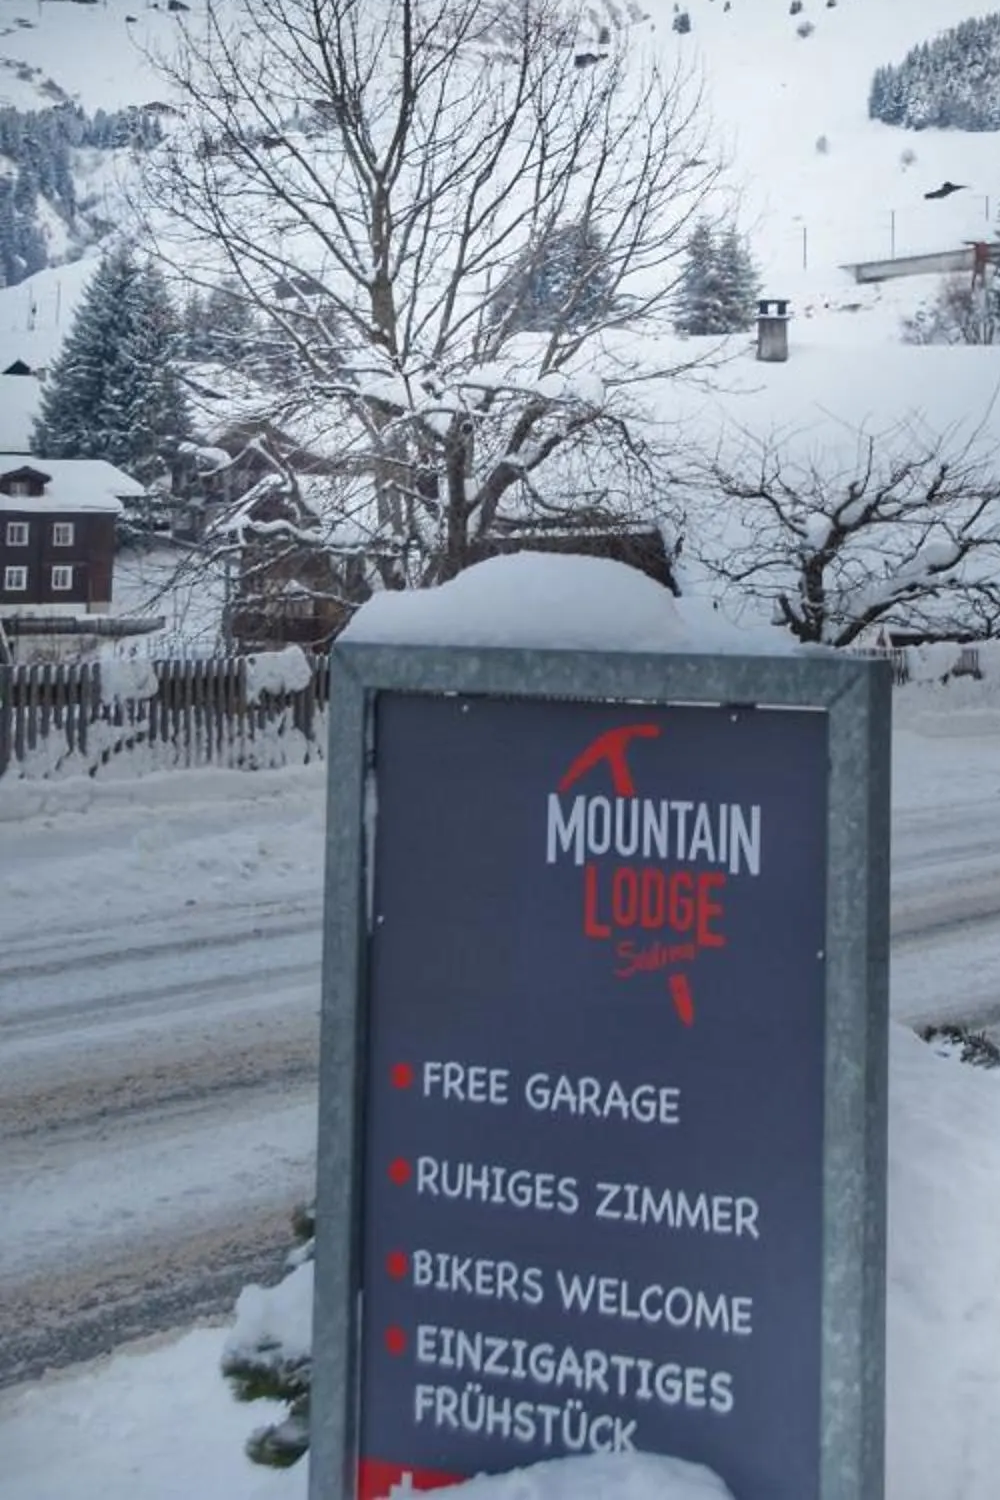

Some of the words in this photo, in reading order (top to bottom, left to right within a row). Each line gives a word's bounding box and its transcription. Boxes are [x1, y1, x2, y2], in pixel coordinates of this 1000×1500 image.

[546, 792, 762, 876] MOUNTAIN
[583, 862, 727, 948] LODGE
[423, 1062, 509, 1104] FREE
[525, 1073, 681, 1124] GARAGE
[416, 1156, 579, 1214] RUHIGES
[596, 1182, 760, 1239] ZIMMER
[412, 1250, 544, 1305] BIKERS
[557, 1270, 754, 1336] WELCOME
[416, 1325, 734, 1414] EINZIGARTIGES
[414, 1382, 638, 1453] FRÜHSTÜCK
